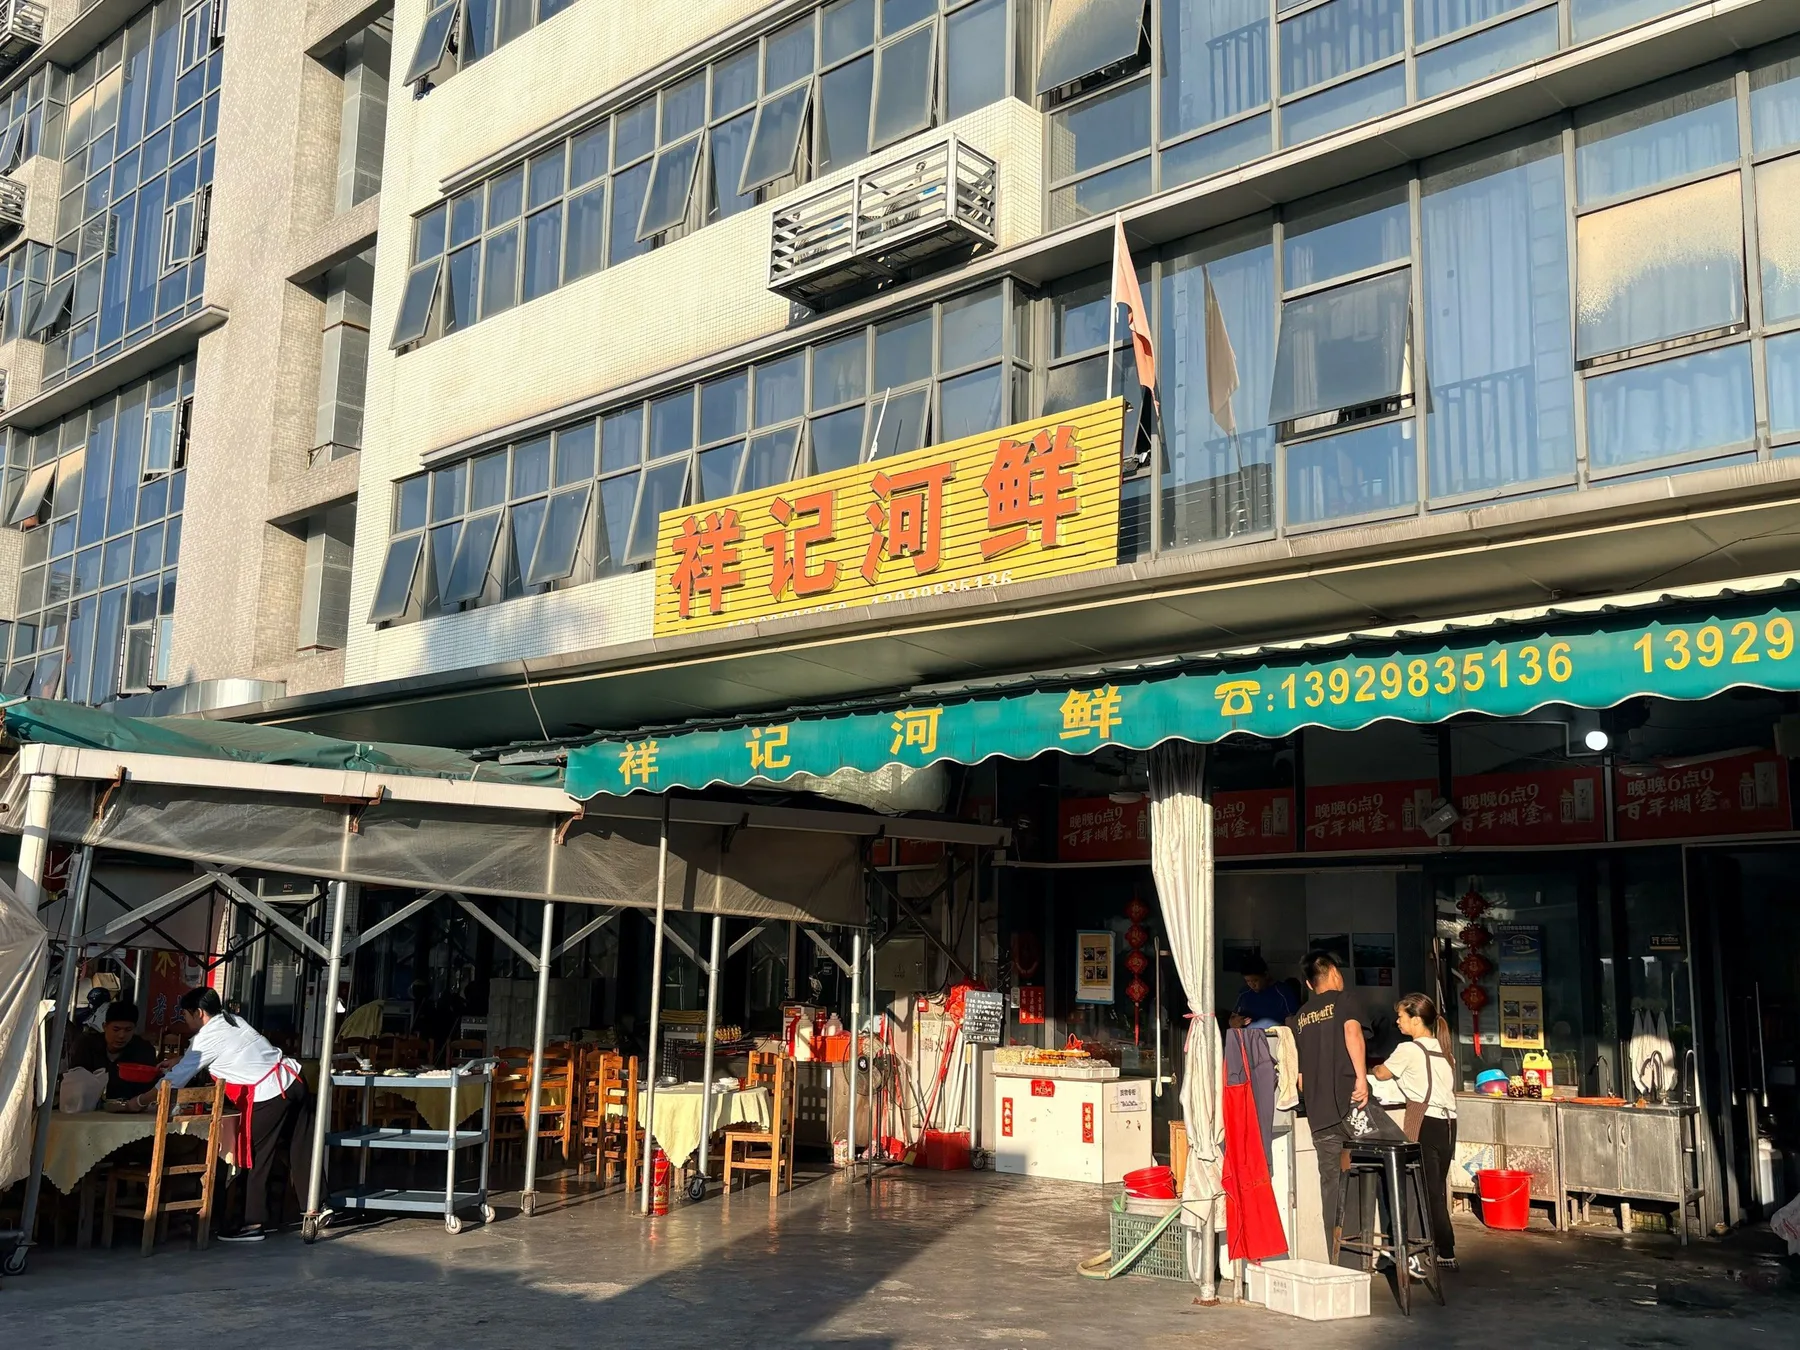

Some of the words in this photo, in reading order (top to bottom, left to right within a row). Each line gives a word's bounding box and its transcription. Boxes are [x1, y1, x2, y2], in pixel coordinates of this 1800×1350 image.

[670, 425, 1082, 620] 祥记河鲜
[1634, 617, 1795, 673] 13929
[618, 686, 1122, 785] 祥记河鲜
[1626, 767, 1715, 797] 晚晚6点9
